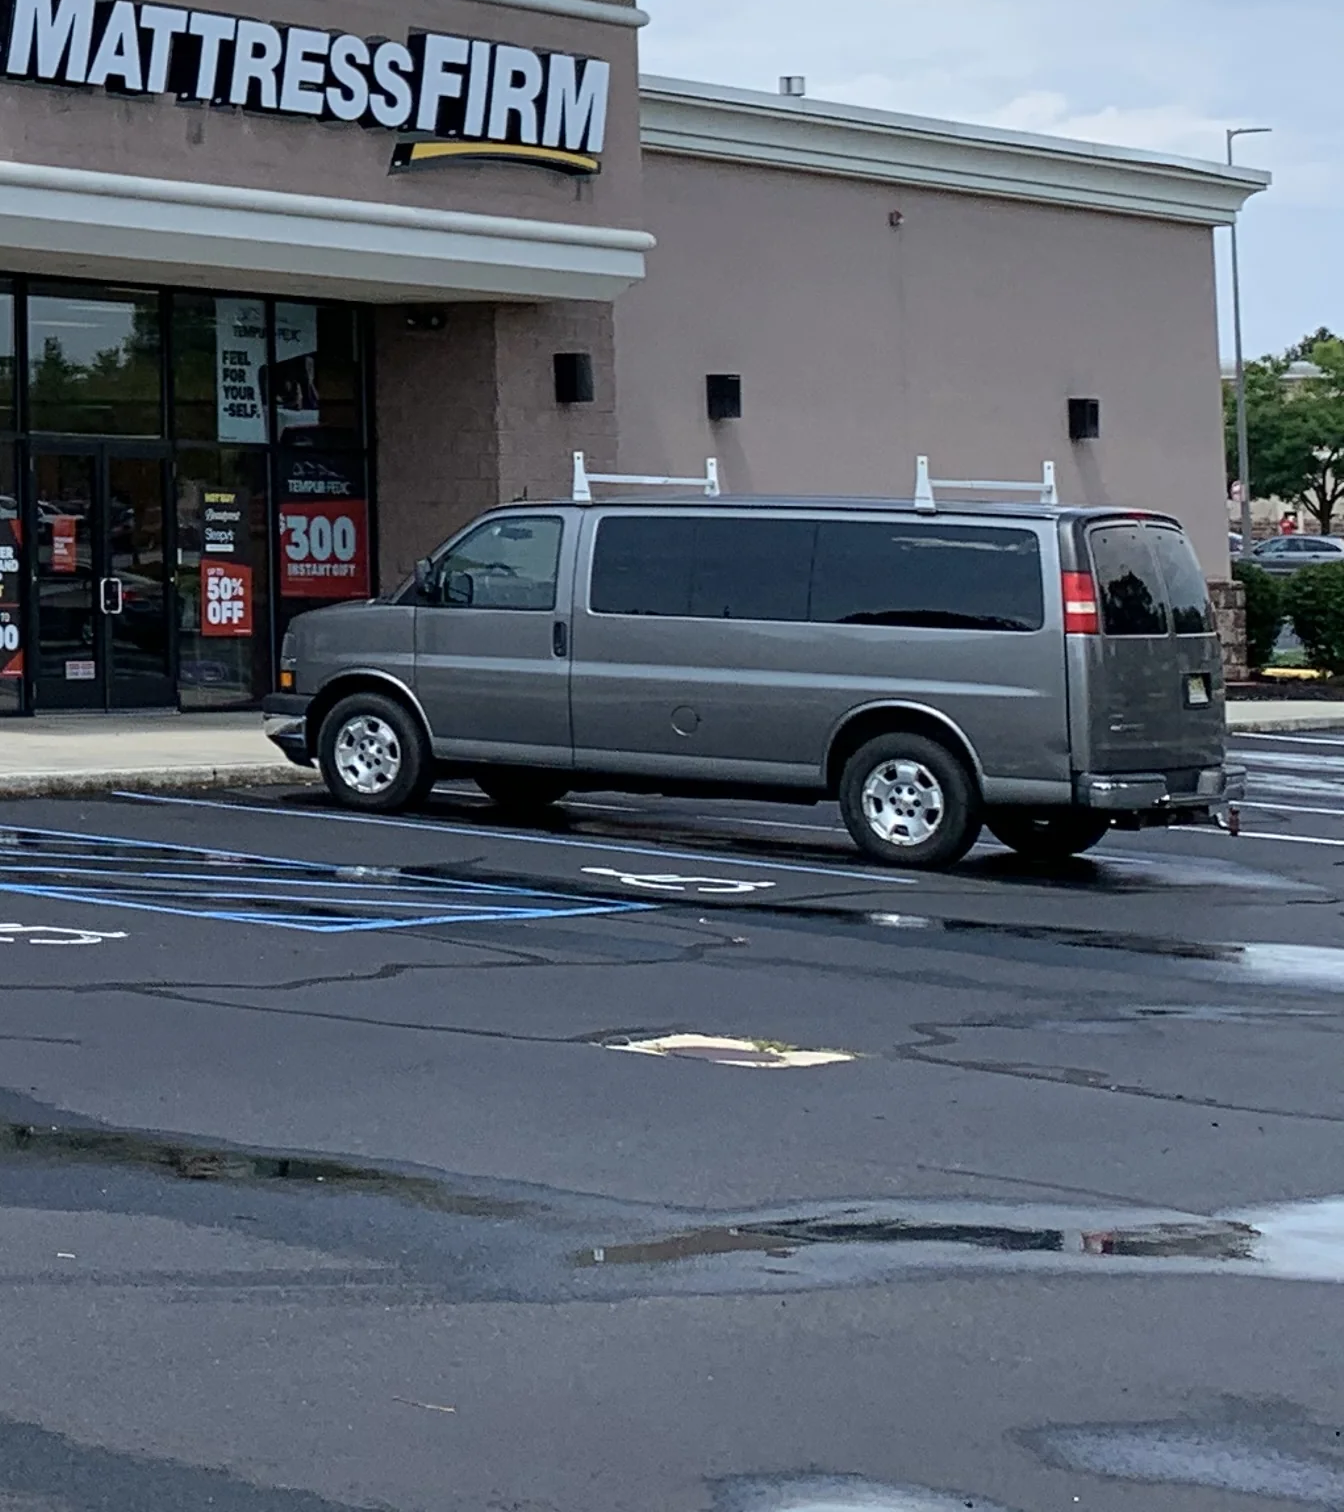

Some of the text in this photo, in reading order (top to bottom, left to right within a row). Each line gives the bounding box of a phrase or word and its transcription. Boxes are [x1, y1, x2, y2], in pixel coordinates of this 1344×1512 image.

[222, 350, 251, 366] FEEL
[223, 368, 247, 383] FOR
[223, 386, 255, 401] YOUR
[279, 513, 356, 561] $300
[207, 576, 244, 600] 50%
[207, 600, 244, 624] OFF
